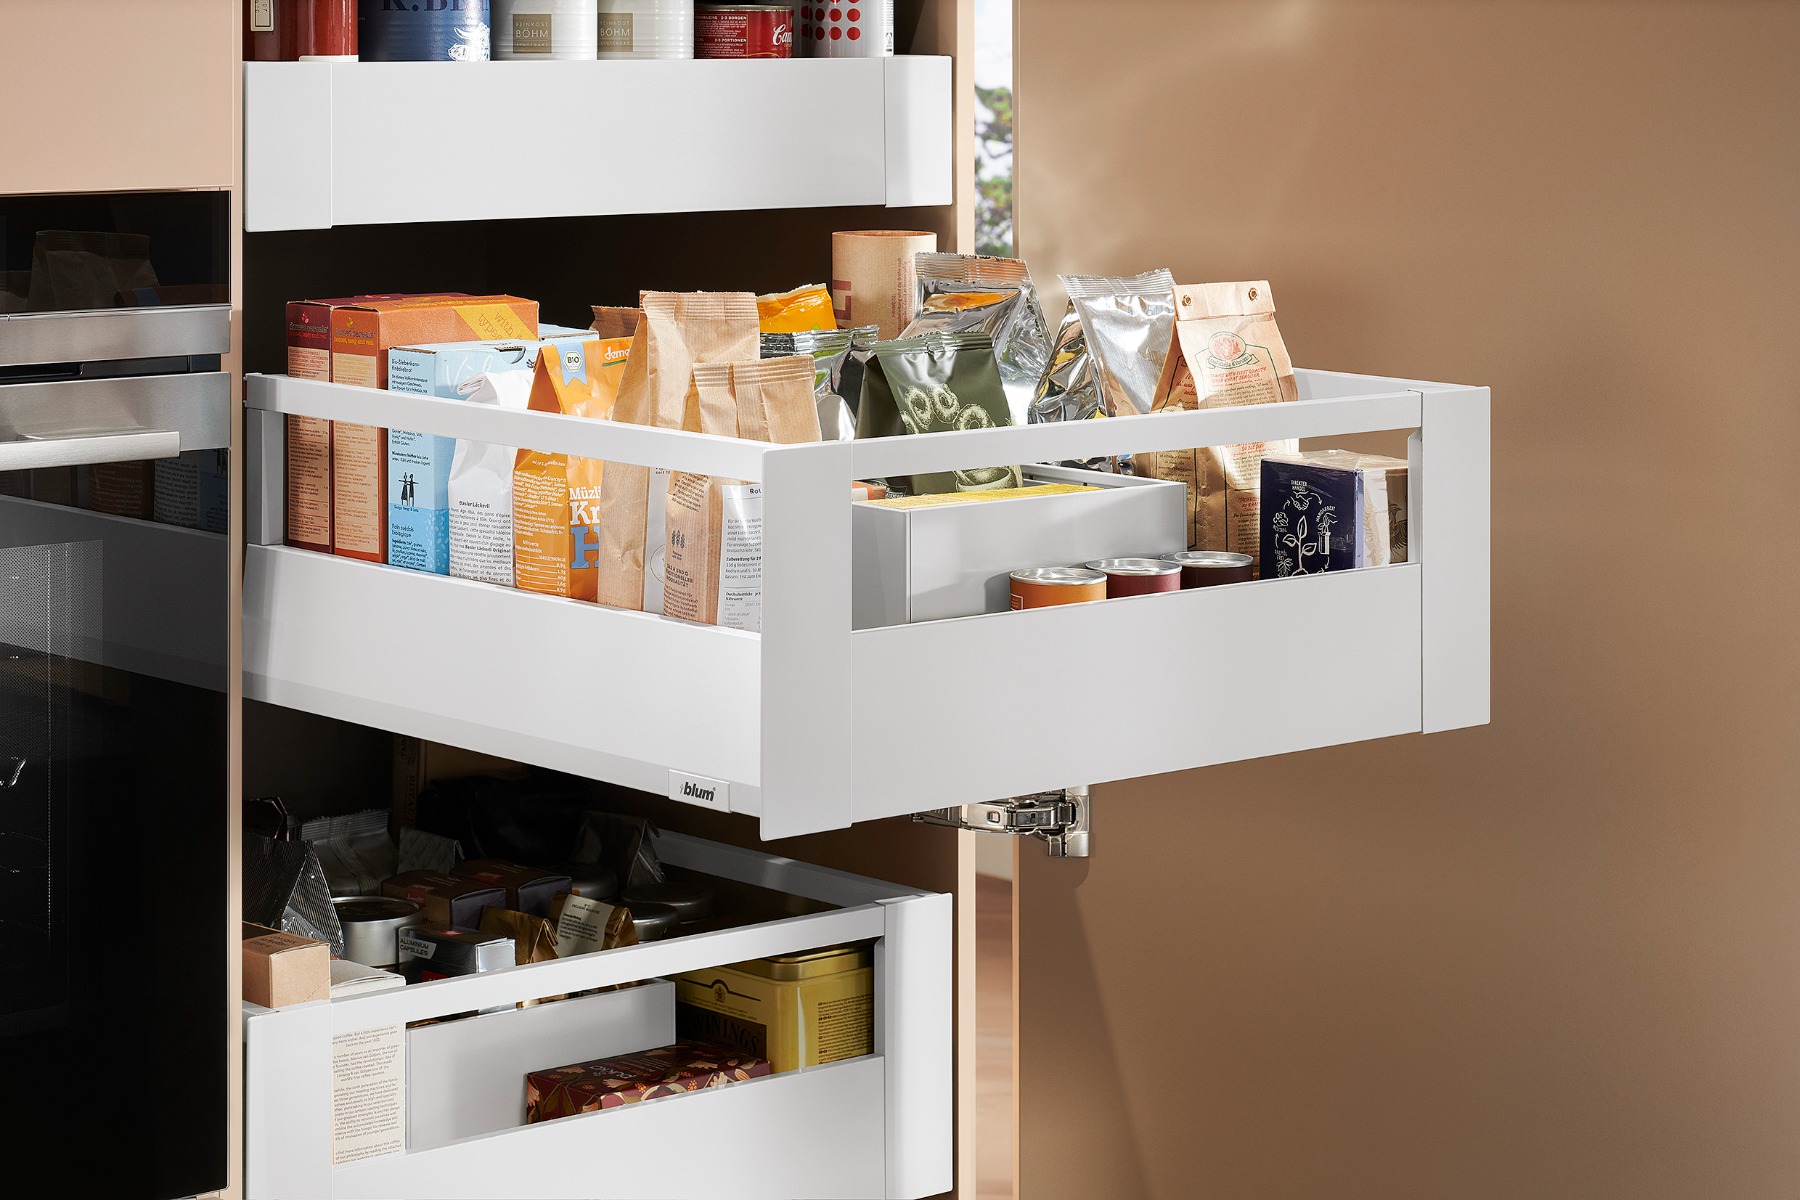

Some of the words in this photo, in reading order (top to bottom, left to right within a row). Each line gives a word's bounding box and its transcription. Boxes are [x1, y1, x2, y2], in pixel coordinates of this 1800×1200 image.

[516, 28, 548, 38] BÖHM
[600, 27, 630, 36] BÖHM
[494, 312, 514, 337] with
[684, 782, 714, 801] blum
[400, 938, 428, 949] ALUMINIUM
[400, 944, 428, 956] CAPSULES
